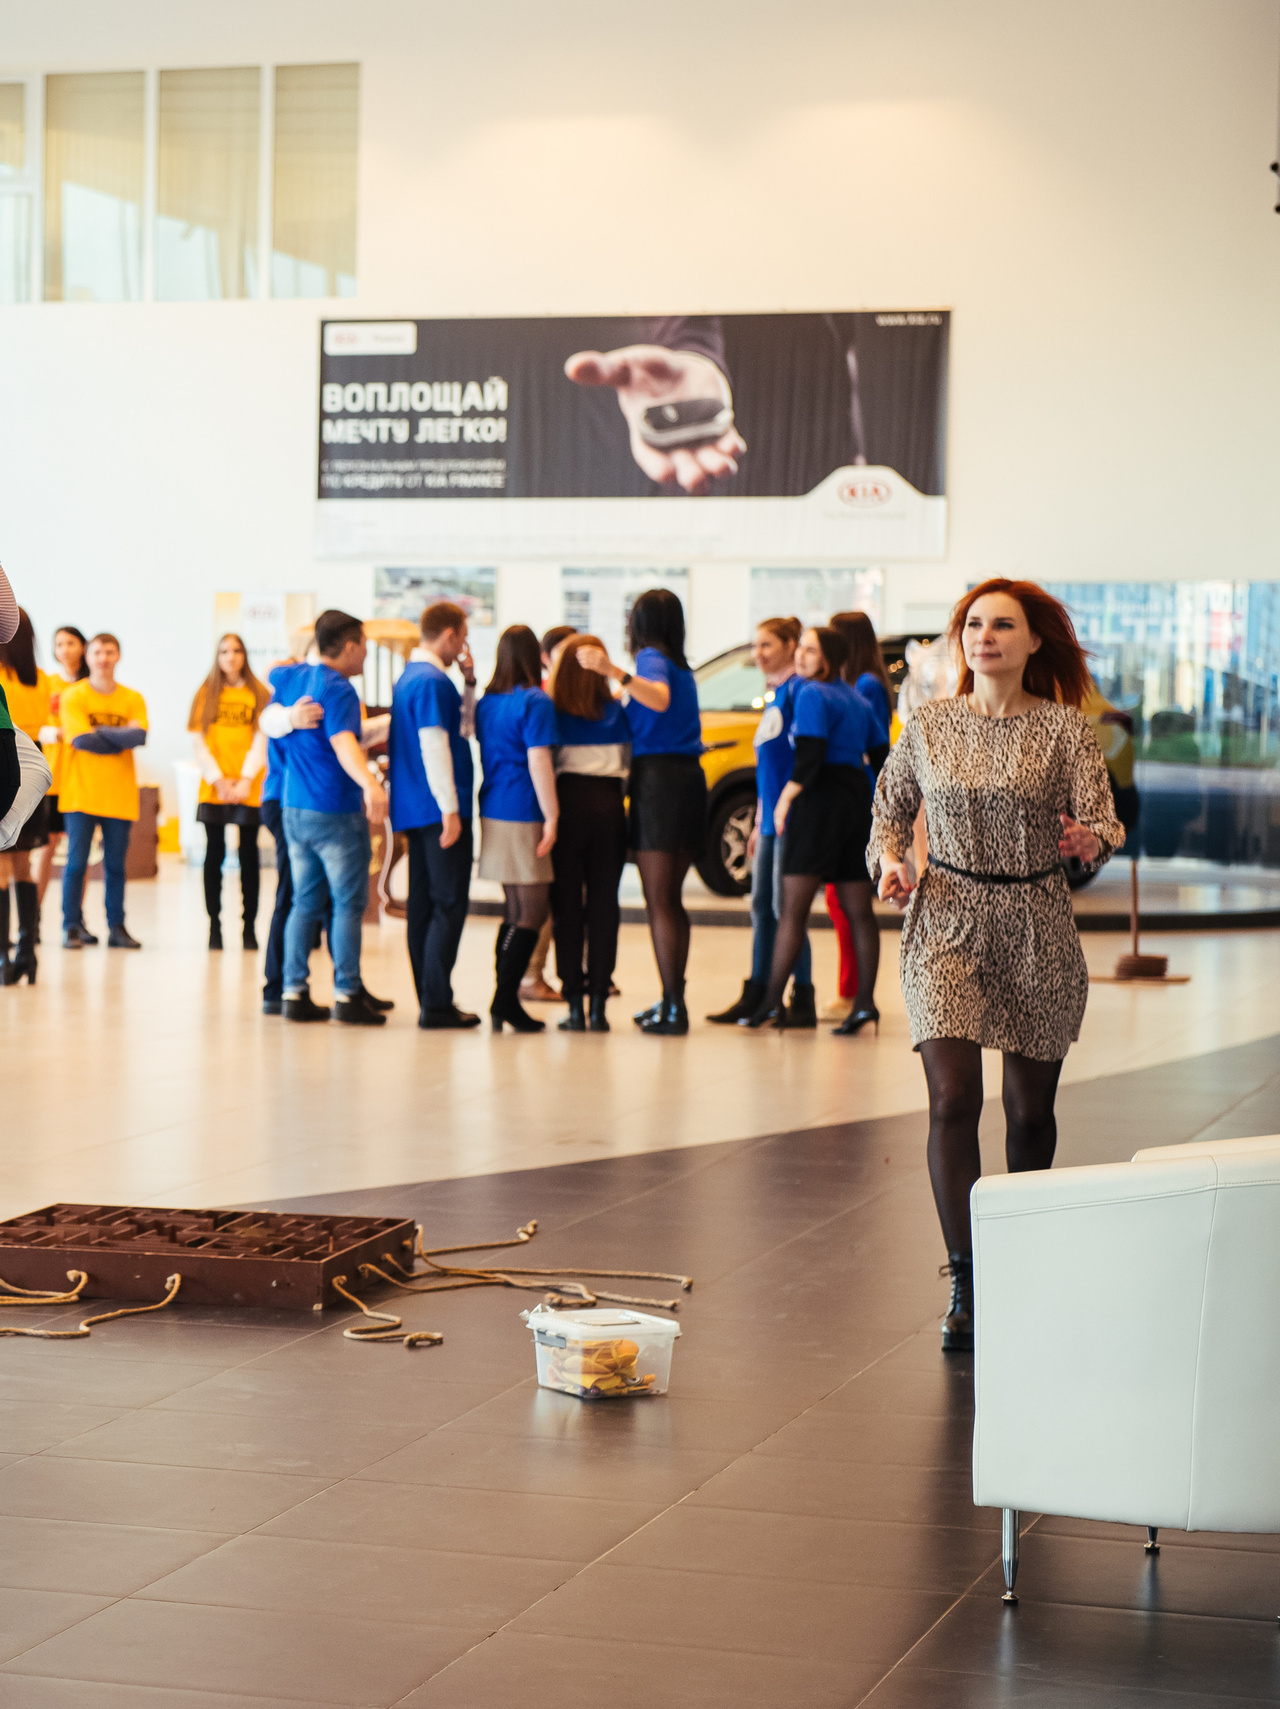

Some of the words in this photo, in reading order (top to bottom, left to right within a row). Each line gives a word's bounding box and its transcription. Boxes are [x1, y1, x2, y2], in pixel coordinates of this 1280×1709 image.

[322, 376, 508, 416] ВОПЛОЩАЙ
[322, 418, 410, 444] МЕЧТУ
[414, 417, 507, 443] ЛЕГКО!
